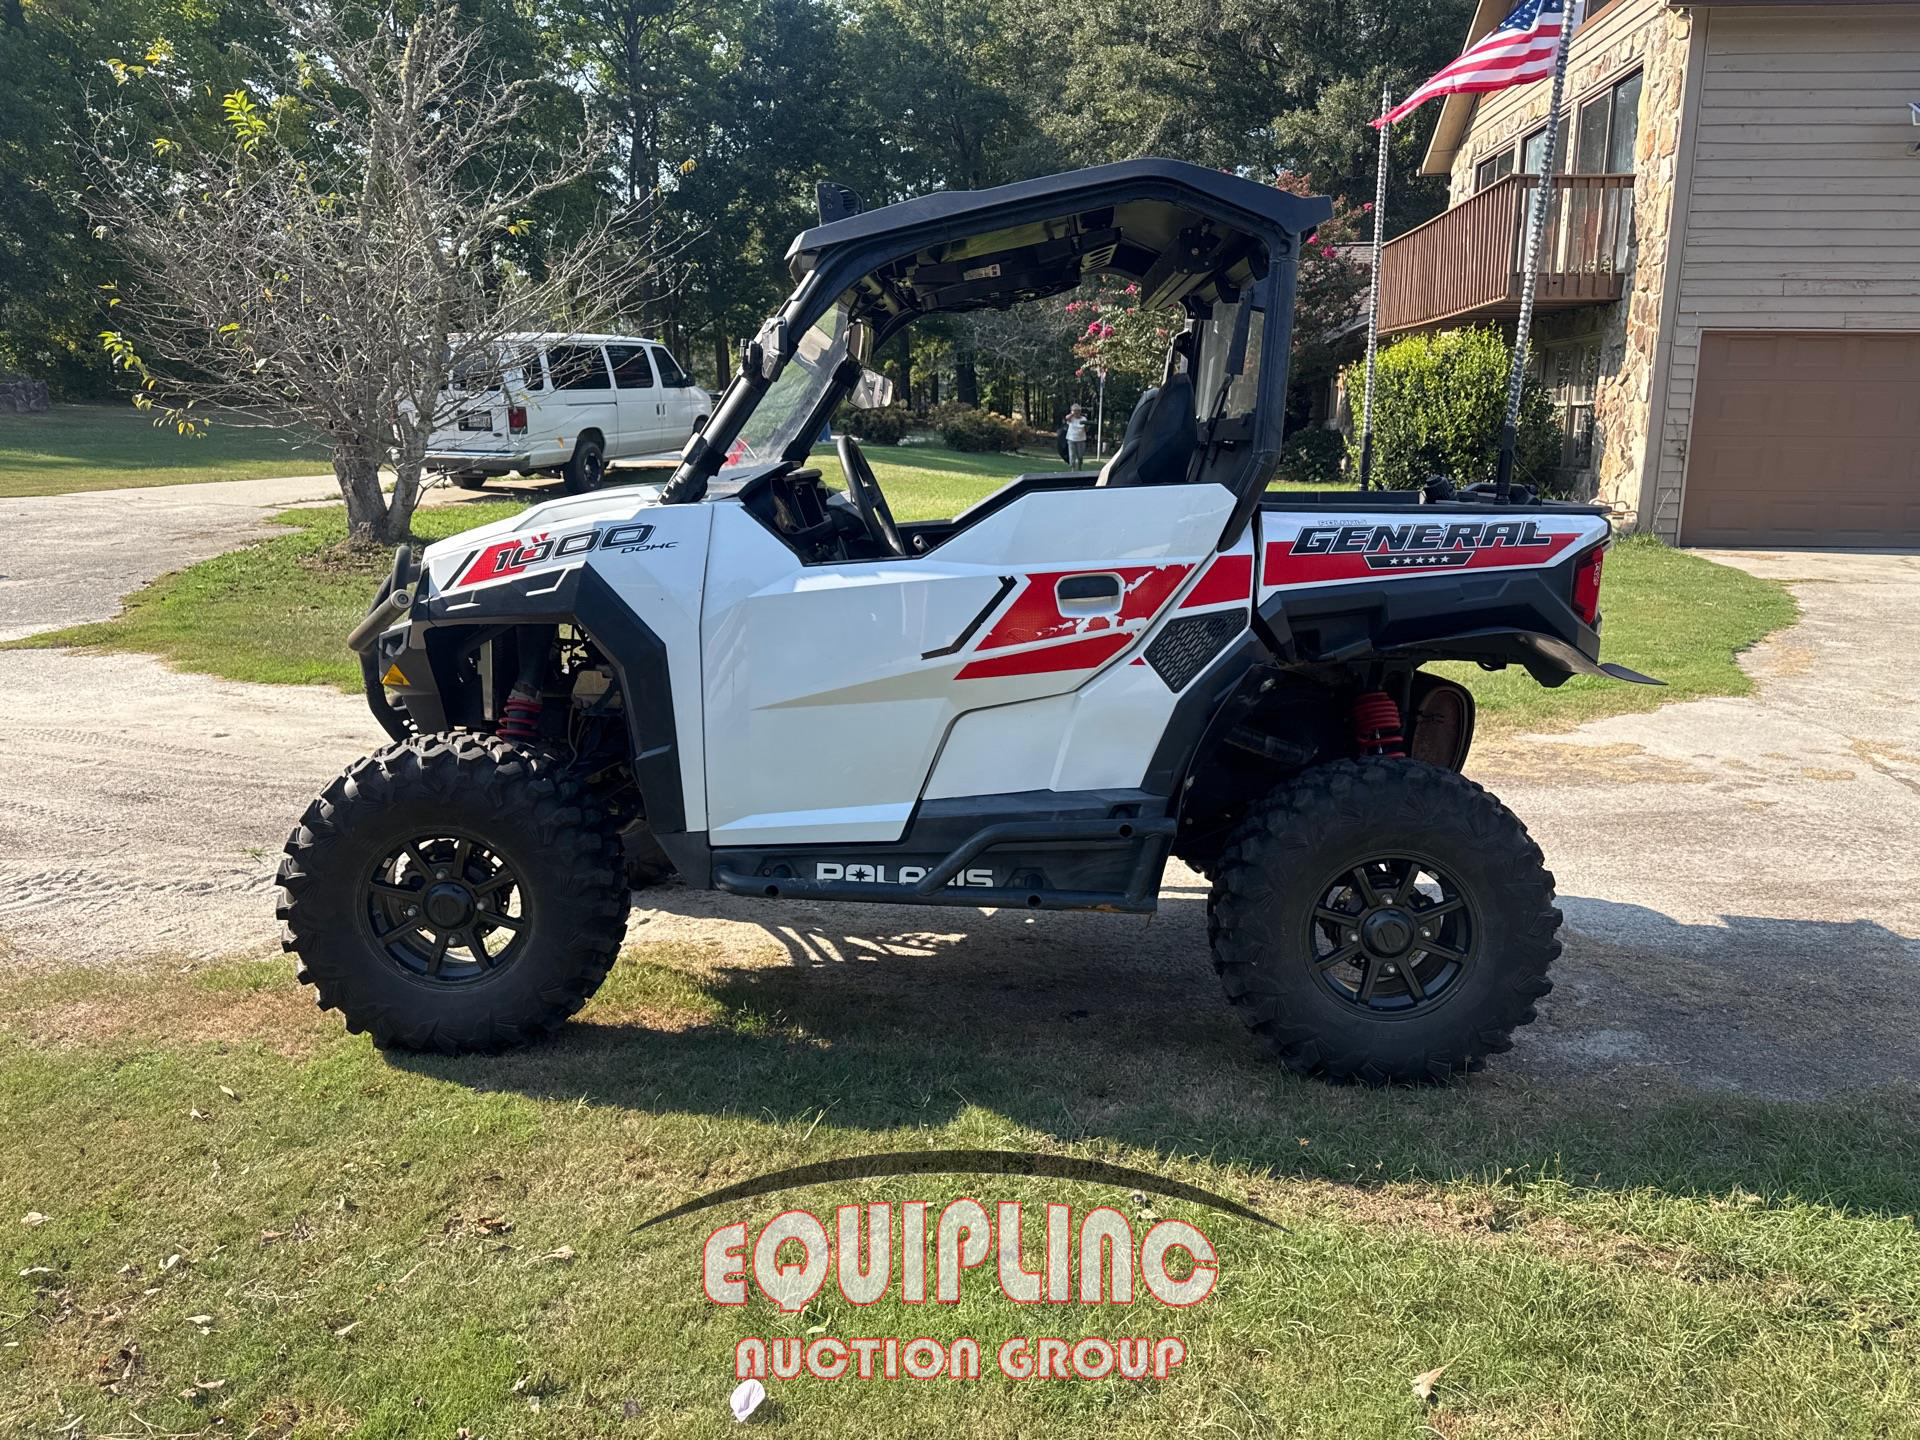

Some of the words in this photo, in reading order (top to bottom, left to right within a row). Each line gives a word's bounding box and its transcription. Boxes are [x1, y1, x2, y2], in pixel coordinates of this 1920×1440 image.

[493, 523, 657, 573] 1000
[620, 541, 680, 554] DOHC
[1288, 521, 1552, 556] GENERAL
[816, 862, 994, 888] POLAIS
